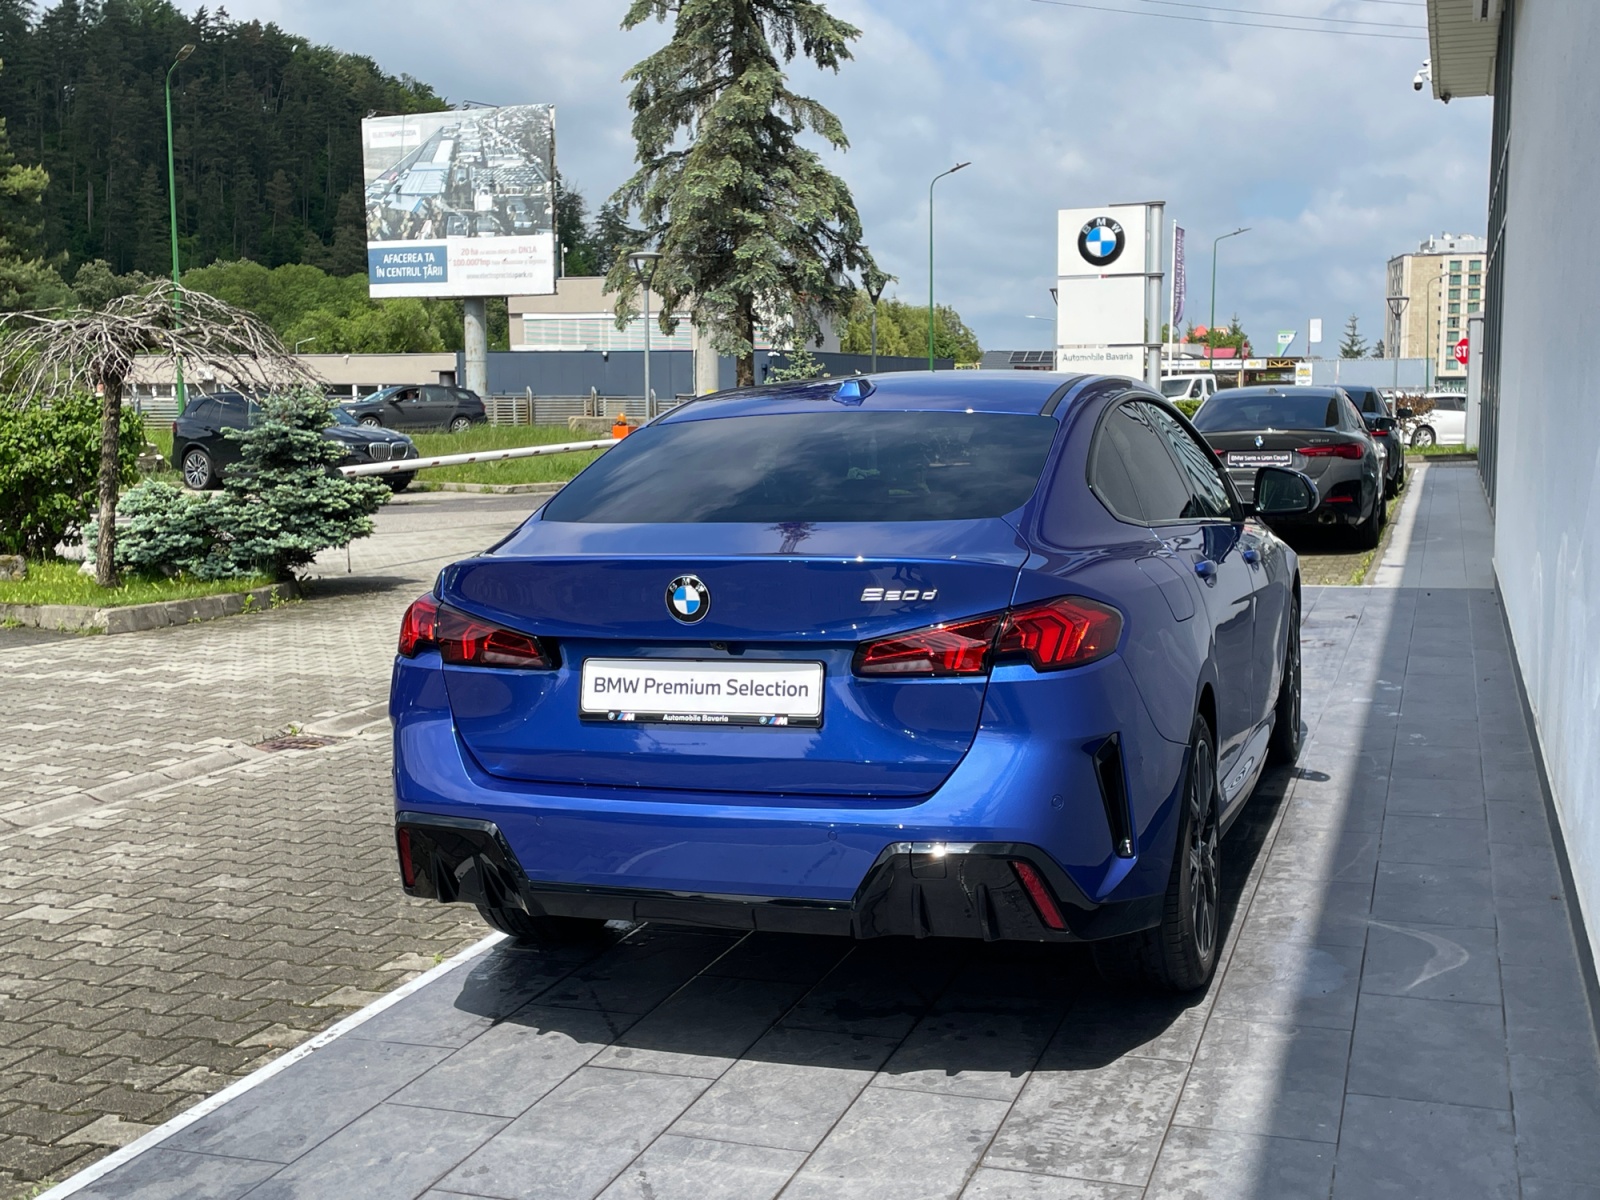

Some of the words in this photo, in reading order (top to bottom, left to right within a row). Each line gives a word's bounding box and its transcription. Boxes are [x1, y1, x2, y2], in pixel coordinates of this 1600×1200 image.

[1081, 217, 1122, 235] BMW
[460, 248, 470, 256] 20
[470, 247, 479, 256] ha
[518, 245, 537, 254] DN1A
[383, 252, 423, 264] AFACEREA
[424, 252, 436, 263] TA
[375, 265, 385, 278] ÎN
[386, 266, 422, 278] CENTRUL
[1062, 353, 1105, 362] Automobile
[1105, 352, 1134, 361] Bavaria
[1456, 345, 1468, 358] ST
[669, 577, 705, 593] BMW
[593, 677, 640, 694] BMW
[644, 677, 721, 696] Premium
[726, 678, 809, 697] Selection
[662, 714, 701, 722] Automobile
[702, 714, 729, 722] Bavaria
